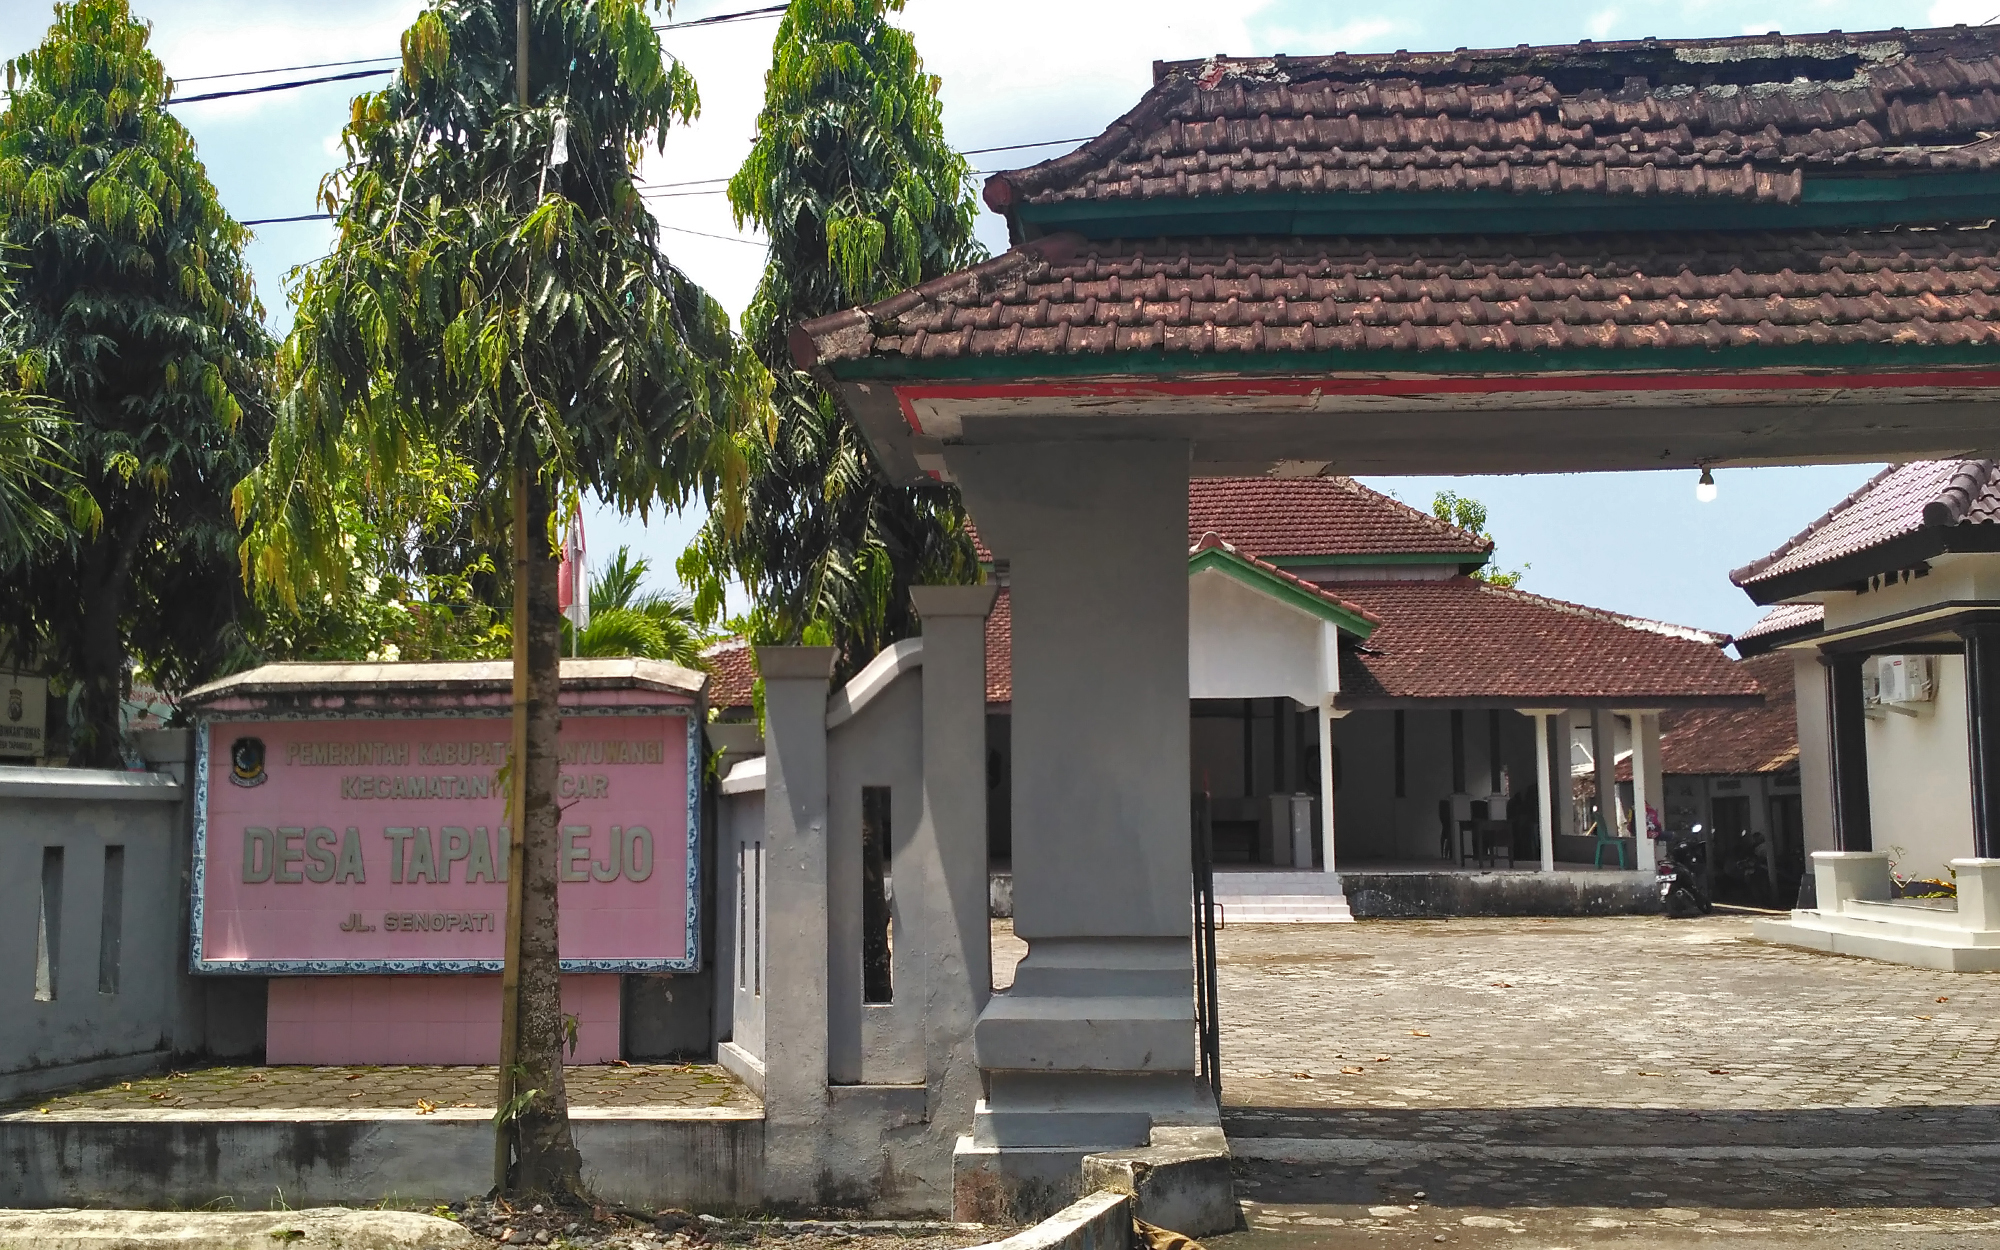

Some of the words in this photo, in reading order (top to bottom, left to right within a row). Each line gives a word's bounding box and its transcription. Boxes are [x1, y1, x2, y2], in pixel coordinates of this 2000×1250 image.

[286, 741, 409, 766] PEMERINTAH
[419, 740, 513, 766] KABUPAT
[557, 740, 664, 765] NYUWANGI
[341, 775, 489, 799] KECAMATAN
[242, 826, 366, 884] DESA
[384, 825, 654, 884] TAPAEJO
[340, 913, 376, 932] JL.
[384, 913, 495, 932] SENOPATI
